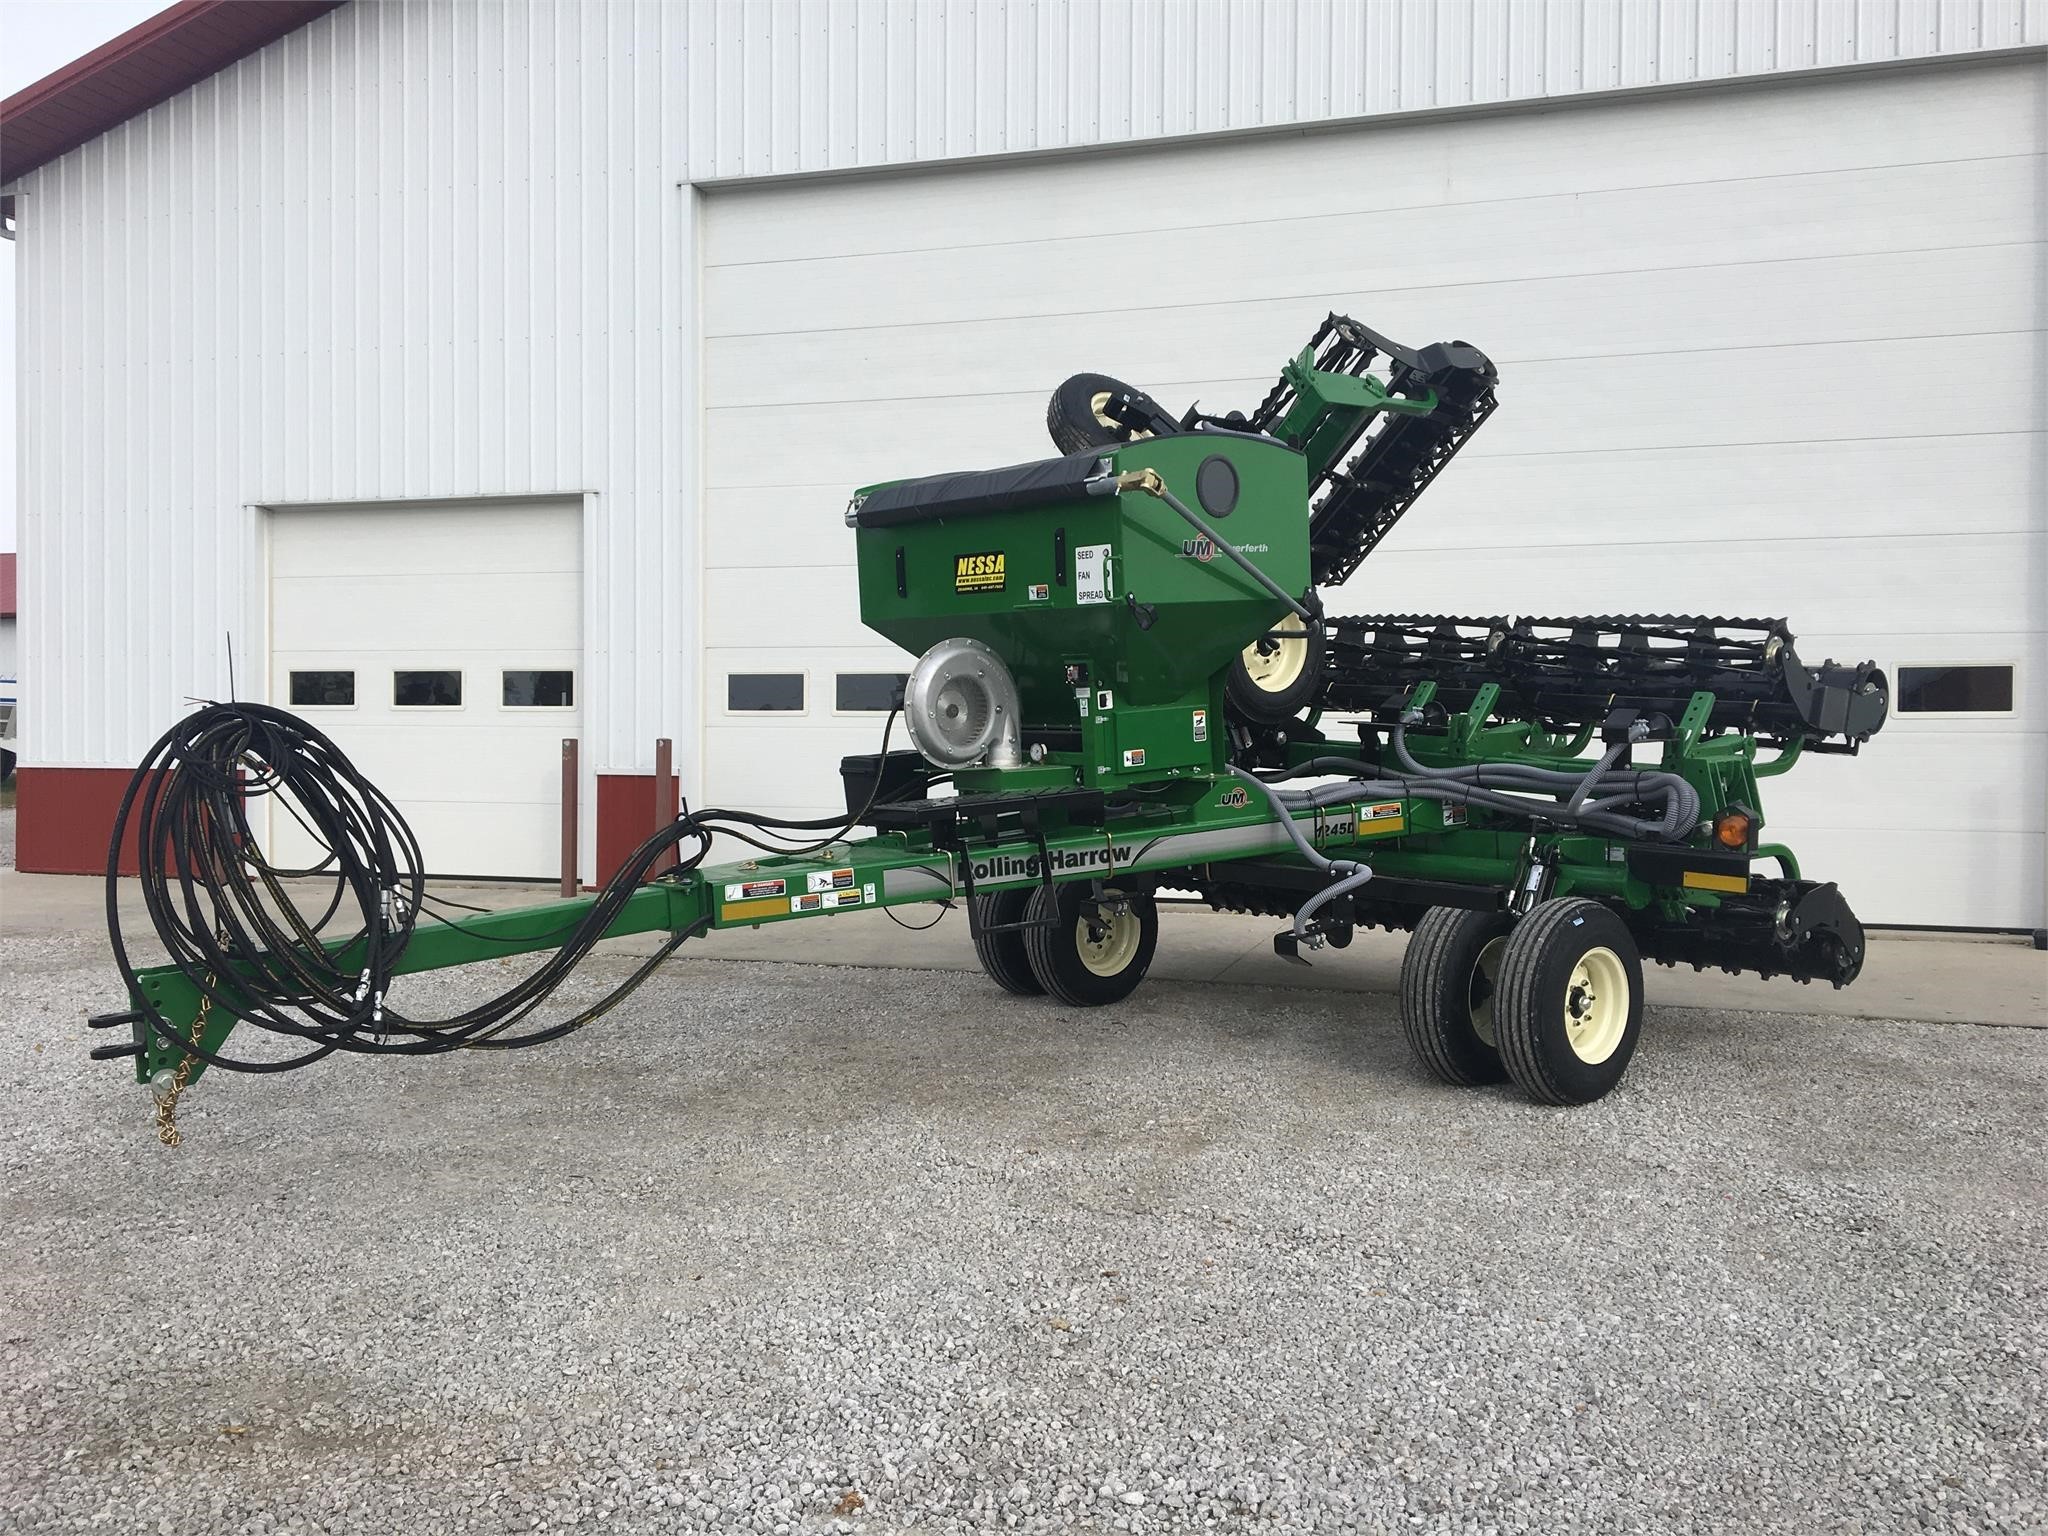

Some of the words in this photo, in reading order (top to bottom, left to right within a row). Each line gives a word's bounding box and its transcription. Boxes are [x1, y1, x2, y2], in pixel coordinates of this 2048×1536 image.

[1183, 540, 1211, 556] UM
[1077, 550, 1094, 560] SEED
[957, 554, 1005, 576] NESSA
[1078, 571, 1091, 580] FAN
[1078, 590, 1104, 601] SPREAD
[1221, 793, 1244, 805] UM
[1048, 846, 1131, 870] Harrow
